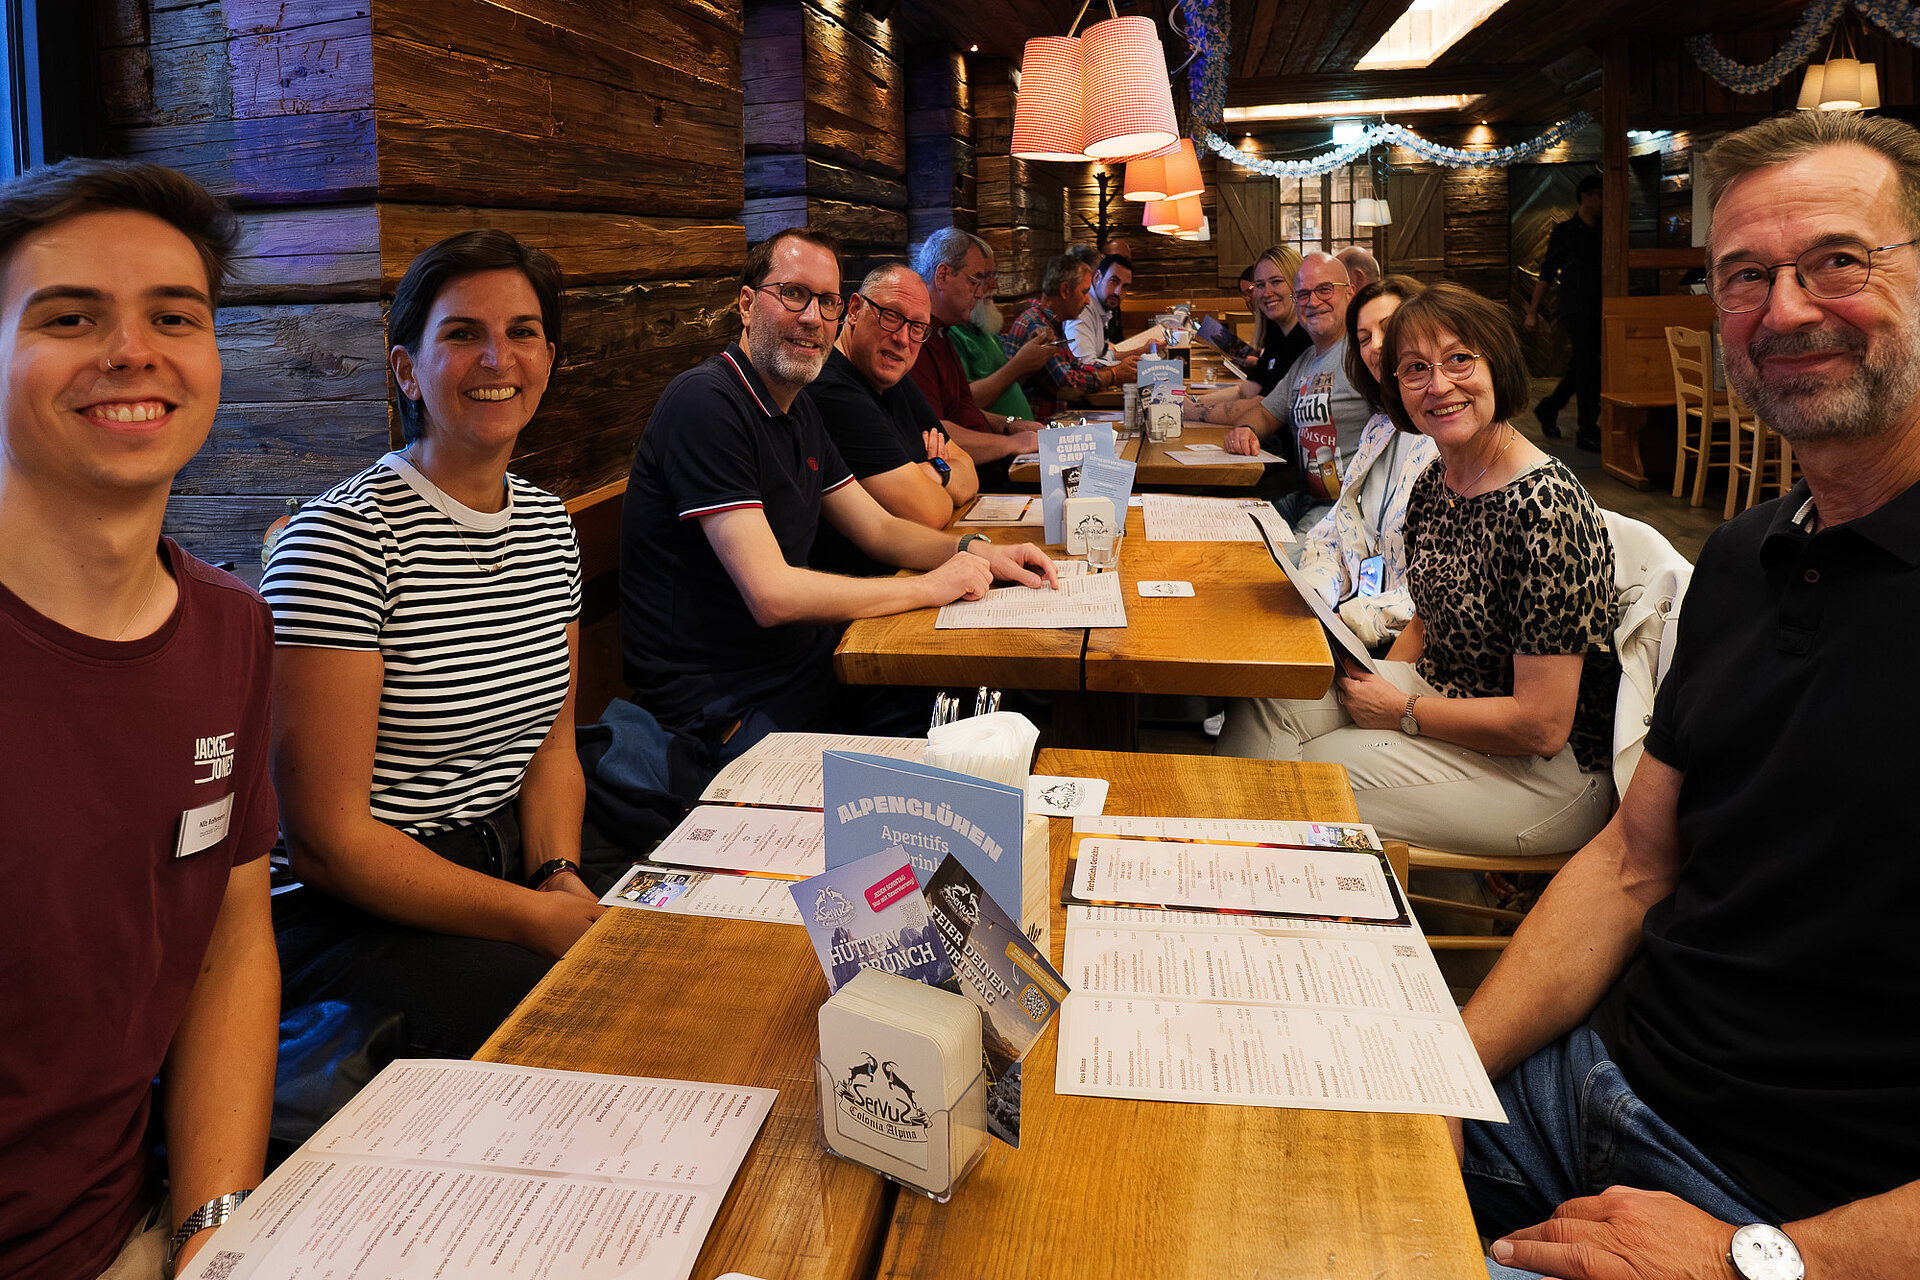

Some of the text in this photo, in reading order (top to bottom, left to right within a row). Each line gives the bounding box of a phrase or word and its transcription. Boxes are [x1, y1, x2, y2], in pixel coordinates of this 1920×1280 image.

[836, 795, 1003, 863] ALPENGLÜHEN
[880, 824, 950, 854] Aperitifs
[827, 929, 900, 967] HÜTTEN
[931, 904, 1010, 999] FEIER DEINEN
[939, 929, 996, 1005] BURTSTAG
[849, 1105, 918, 1140] Colonia Alpina
[413, 1172, 444, 1207] Vegetarisch
[390, 1215, 411, 1236] Vegan
[673, 1195, 695, 1233] Schmankerl
[489, 1239, 510, 1264] Garten
